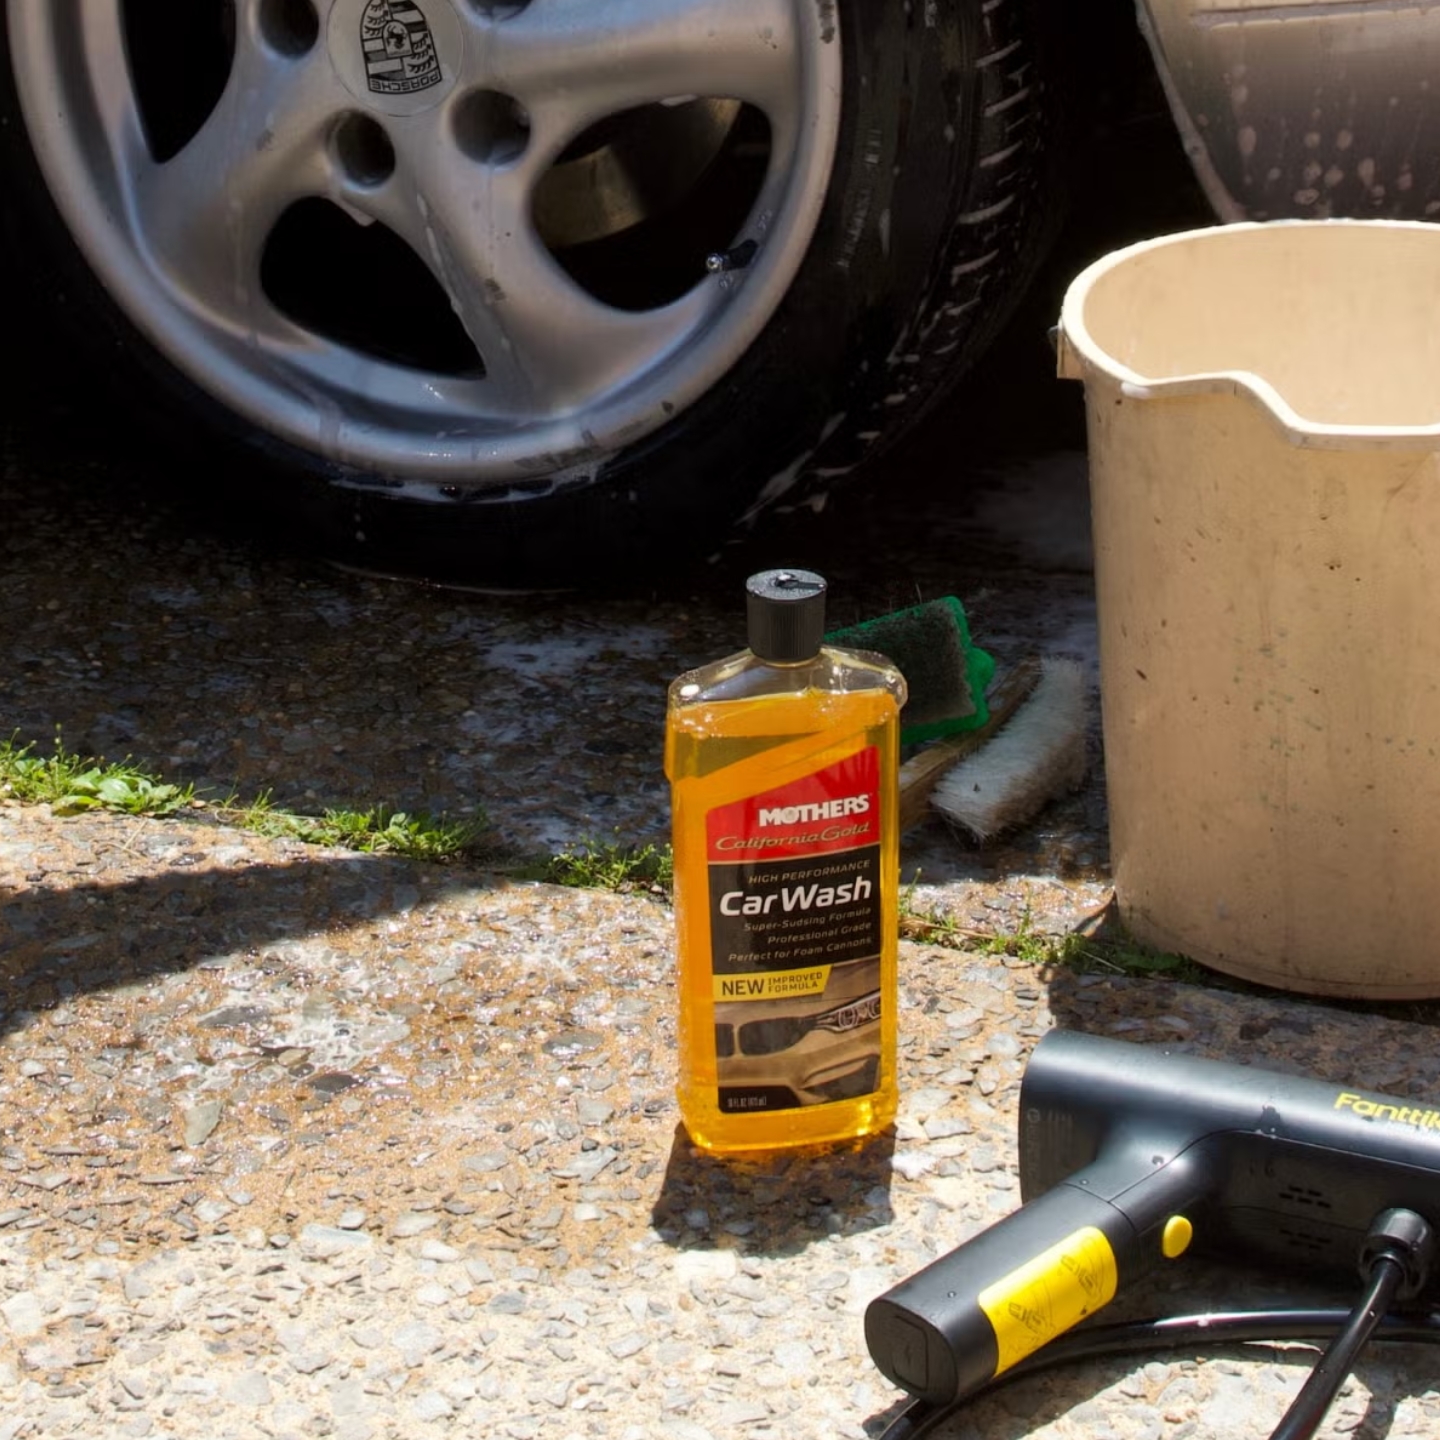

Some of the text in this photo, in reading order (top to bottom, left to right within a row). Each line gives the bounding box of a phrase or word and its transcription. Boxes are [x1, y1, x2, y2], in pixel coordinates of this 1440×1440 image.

[371, 72, 439, 91] PORSCHE
[759, 794, 870, 827] MOTHERS
[715, 822, 871, 851] California Gold
[748, 859, 871, 885] HIGH PERFORMANCE
[719, 876, 872, 916] Car Wash
[744, 907, 872, 933] Super-Sudsing Formula
[766, 921, 872, 945] Professional Grade
[727, 936, 872, 962] Perfect for Foam Cannons
[721, 971, 823, 996] NEW IMPROVED
[767, 980, 819, 994] FORMULA
